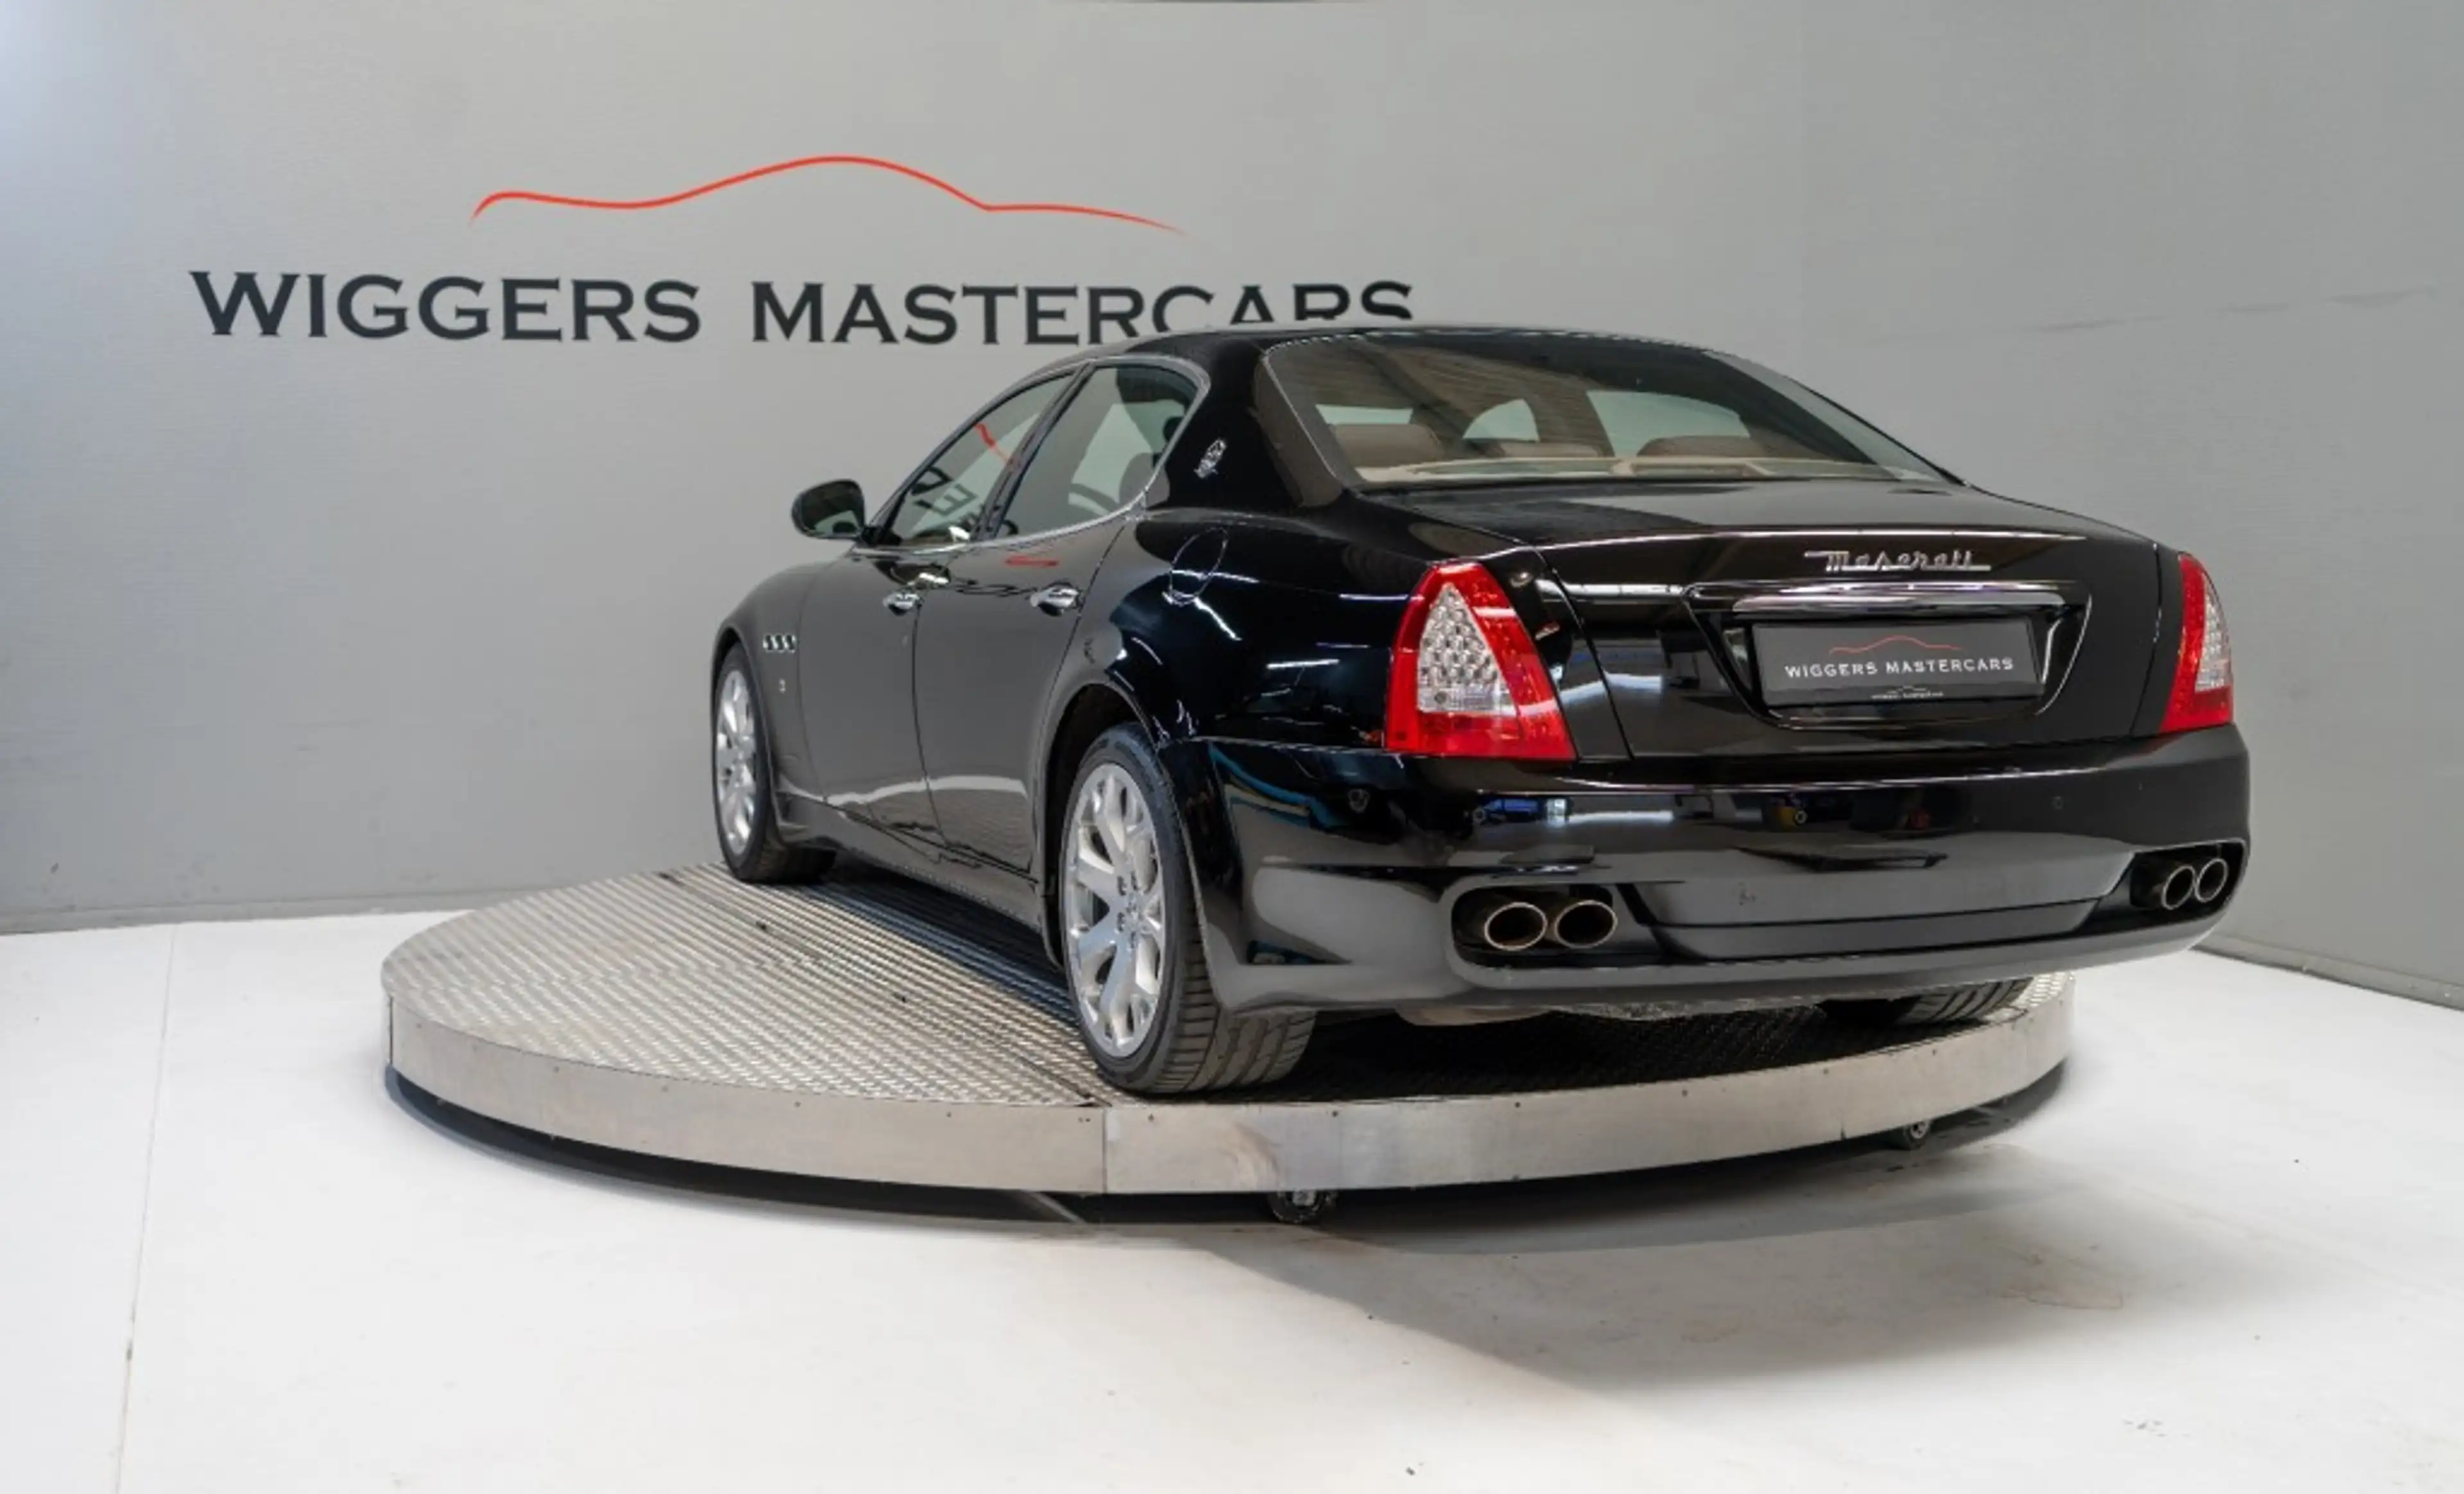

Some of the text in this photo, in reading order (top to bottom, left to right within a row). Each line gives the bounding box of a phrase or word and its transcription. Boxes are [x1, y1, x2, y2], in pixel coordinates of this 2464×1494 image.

[189, 270, 1414, 345] WIGGERS MASTERCARS
[1804, 550, 1992, 572] Maserati
[1784, 657, 2014, 678] WIGGERS MASTERCARS
